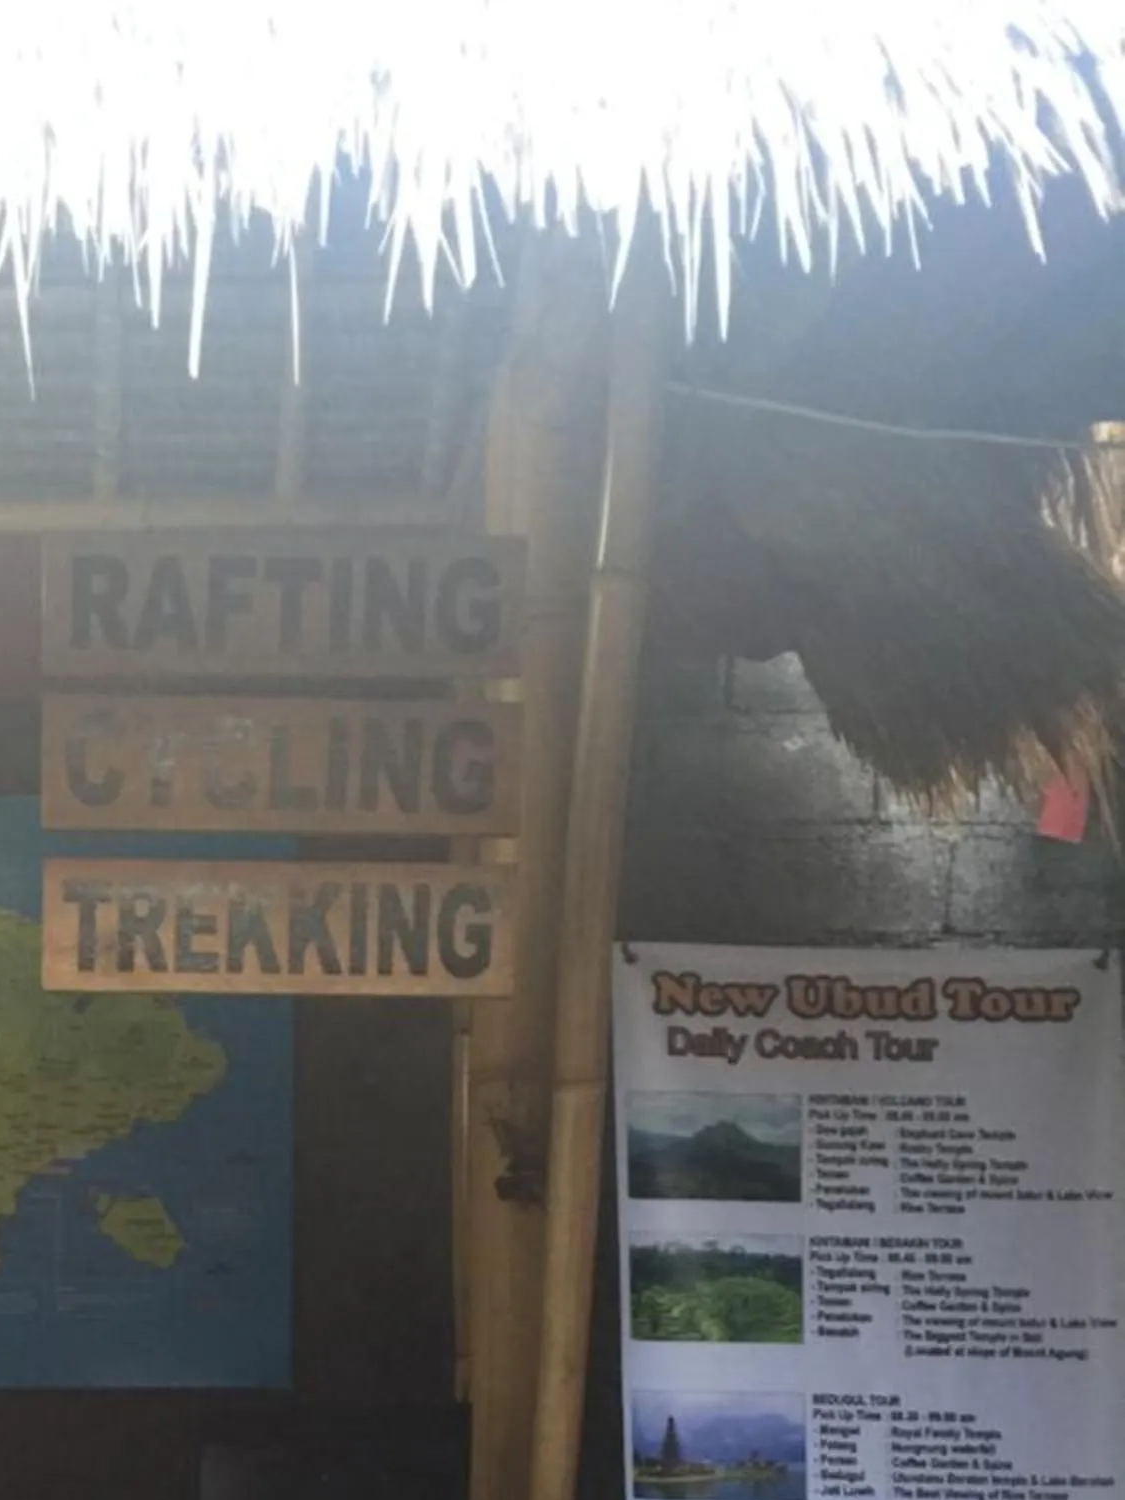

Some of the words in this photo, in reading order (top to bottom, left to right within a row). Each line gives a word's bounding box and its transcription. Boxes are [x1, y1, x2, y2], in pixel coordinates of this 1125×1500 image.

[71, 555, 502, 654] RAFTING
[65, 706, 497, 815] CYCLING
[62, 880, 493, 978] TREKKING
[651, 971, 779, 1018] New
[784, 975, 937, 1021] Ubud
[943, 977, 1079, 1022] Tour
[667, 1026, 746, 1064] Daily
[755, 1028, 858, 1061] Coach
[864, 1030, 939, 1062] Tour
